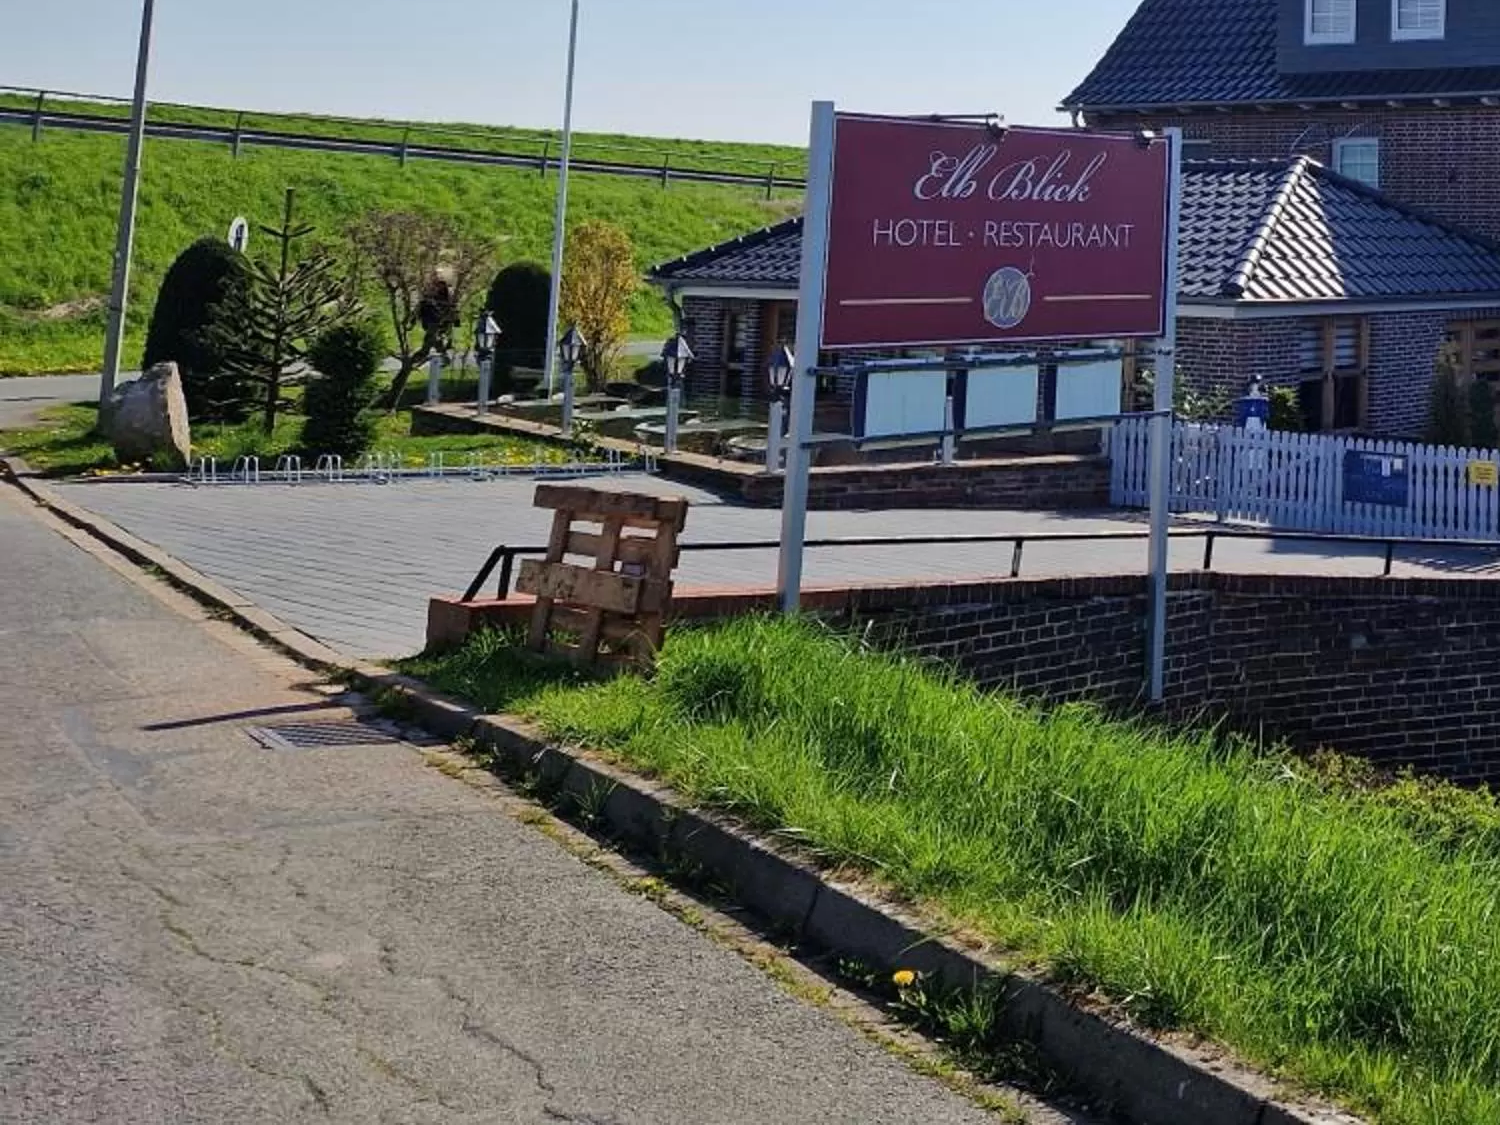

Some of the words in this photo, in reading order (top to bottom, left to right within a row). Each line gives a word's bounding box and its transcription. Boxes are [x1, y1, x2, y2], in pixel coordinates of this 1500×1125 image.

[914, 143, 997, 201] Elb
[988, 150, 1108, 203] Blick
[872, 219, 961, 247] HOTEL
[984, 220, 1135, 248] RESTAURANT
